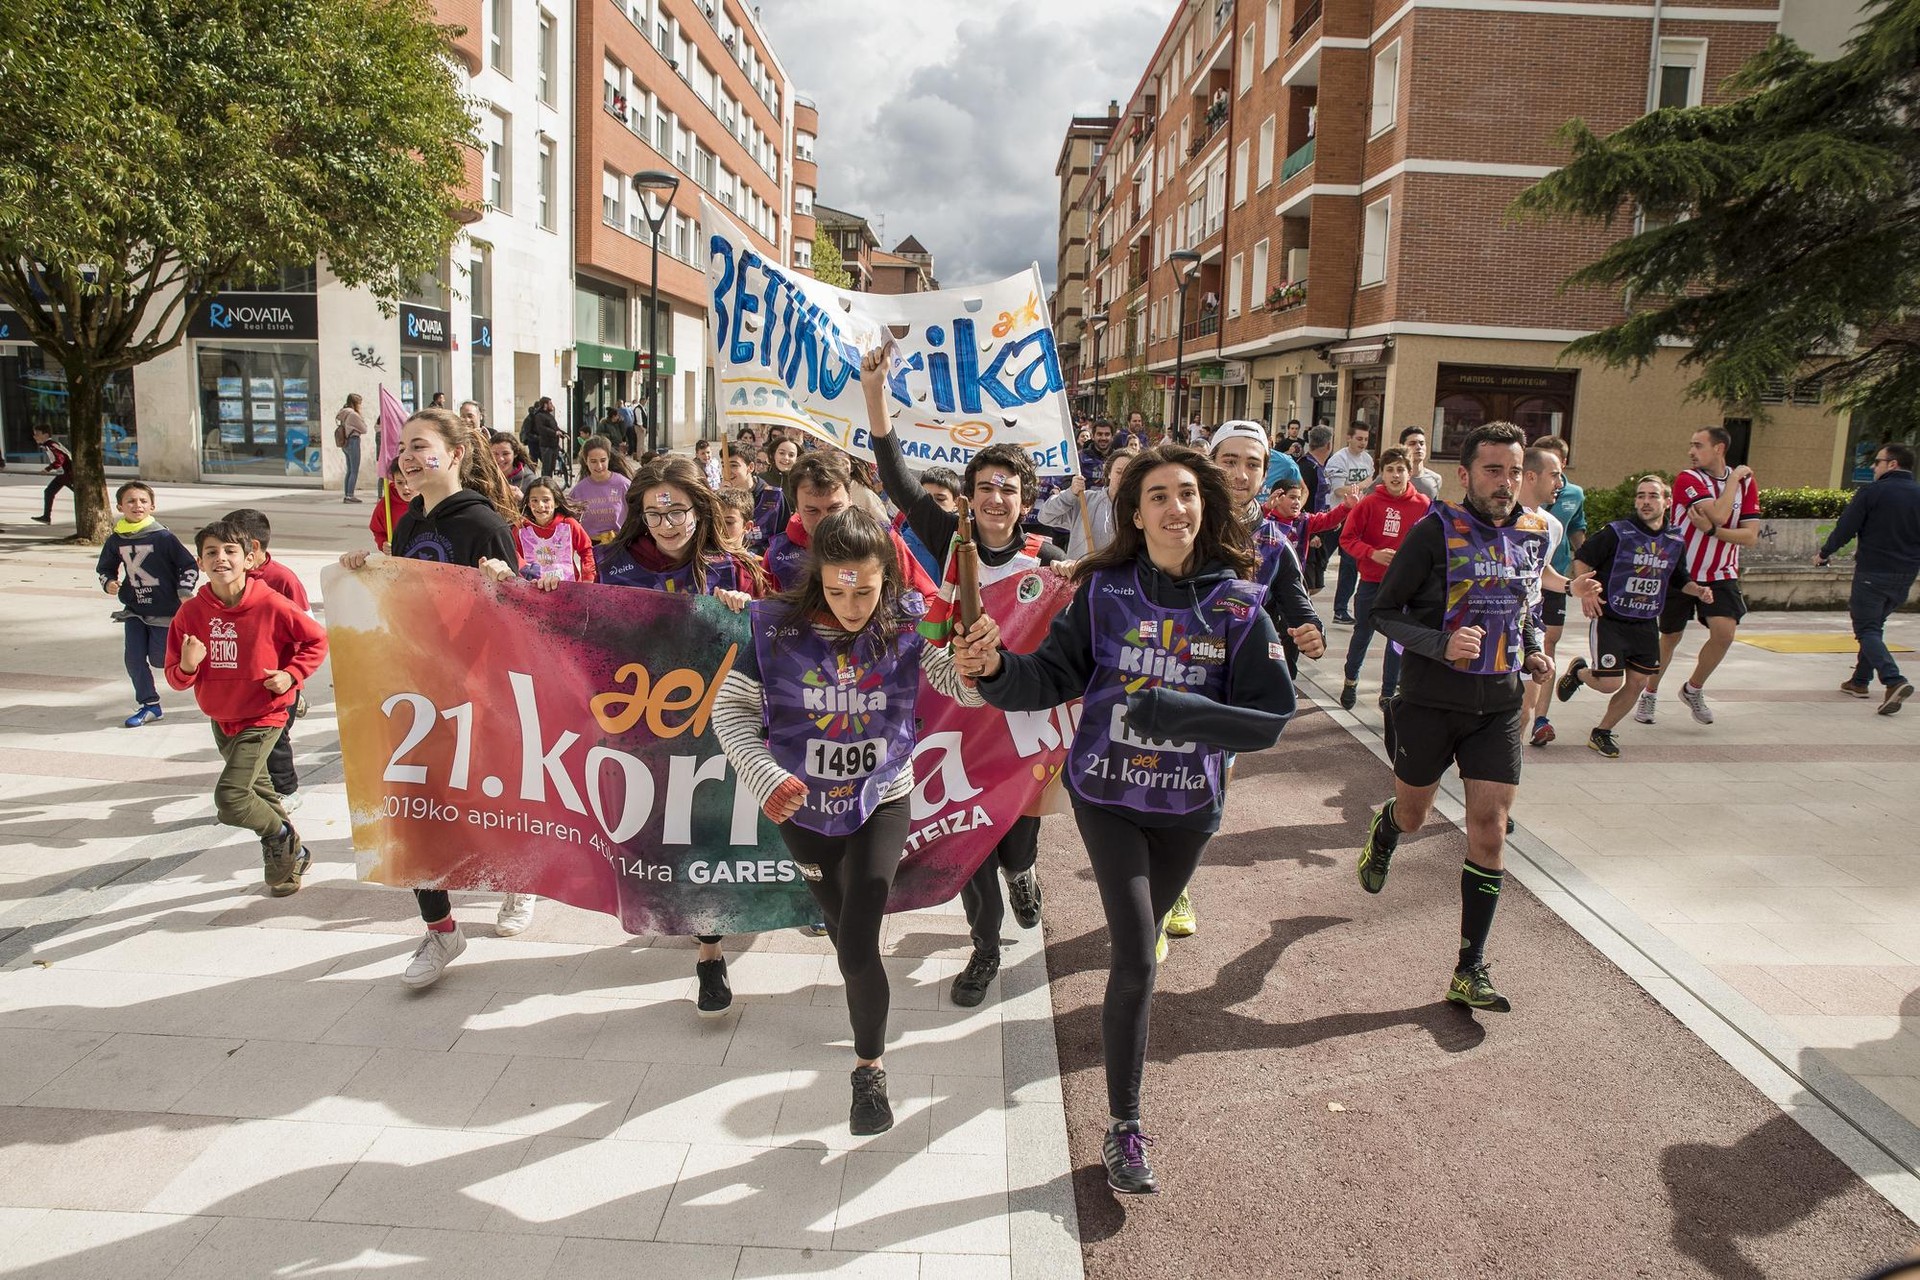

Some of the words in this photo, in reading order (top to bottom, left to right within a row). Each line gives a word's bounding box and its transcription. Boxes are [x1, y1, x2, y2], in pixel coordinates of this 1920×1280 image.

[119, 544, 160, 588] K
[618, 563, 634, 575] eitb
[1633, 553, 1669, 569] Klika
[1114, 586, 1135, 596] eitb
[210, 639, 238, 662] BETIKO
[1190, 642, 1226, 660] Klika
[1118, 645, 1208, 686] Klika
[802, 684, 887, 715] Klika
[814, 742, 877, 777] 1496
[1131, 752, 1161, 769] aek
[1084, 753, 1116, 780] 21.
[1120, 758, 1207, 790] korrika
[828, 781, 857, 798] aek
[382, 795, 459, 822] 2019ko
[468, 809, 582, 844] apirilaren
[618, 857, 673, 882] 14ra
